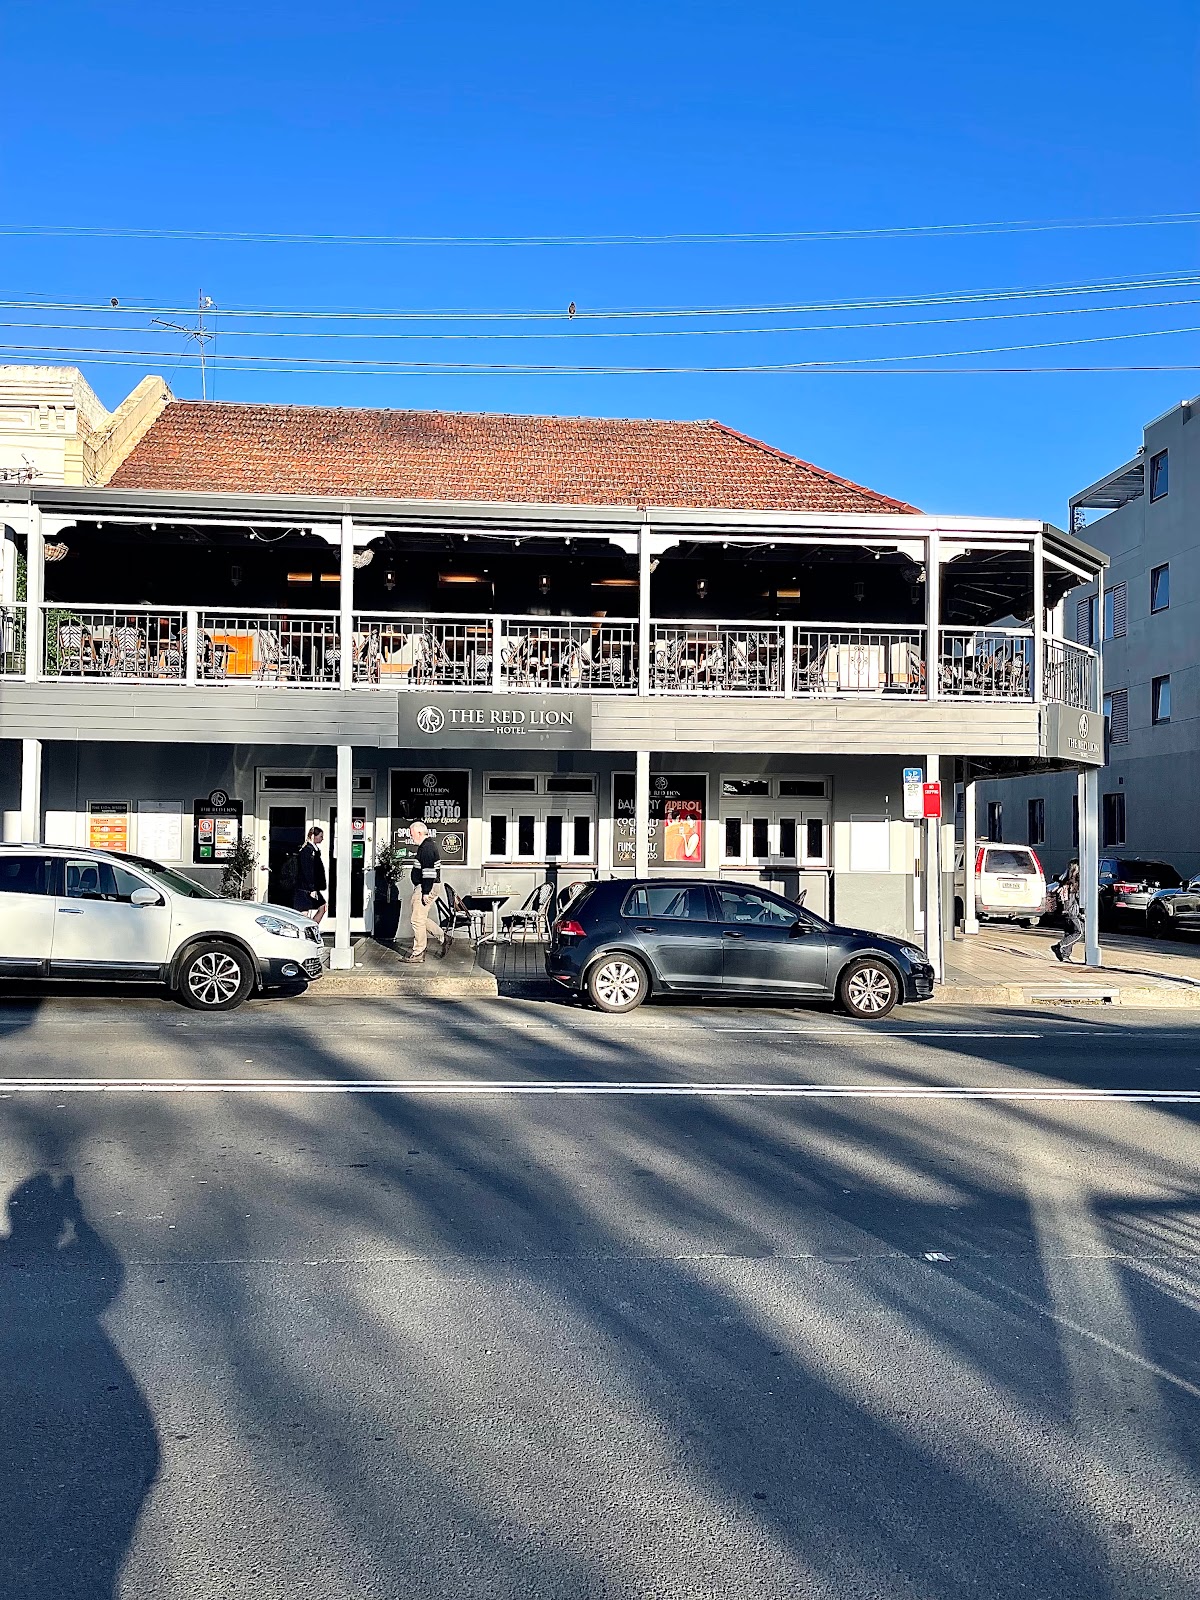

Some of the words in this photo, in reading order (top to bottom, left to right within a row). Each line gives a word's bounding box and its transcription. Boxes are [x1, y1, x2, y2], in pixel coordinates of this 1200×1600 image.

[448, 709, 485, 724] THE
[489, 710, 526, 725] RED
[529, 711, 574, 726] LION
[496, 726, 527, 735] HOTEL
[1068, 737, 1077, 749] THE
[1078, 740, 1087, 750] RED
[1088, 742, 1099, 753] LION
[618, 799, 660, 809] BALNY
[665, 801, 702, 812] APEROL
[424, 806, 460, 818] BISTRO
[617, 818, 659, 827] COCILS
[398, 828, 410, 837] SPO
[630, 827, 655, 836] FD
[618, 842, 657, 851] FUNCNS
